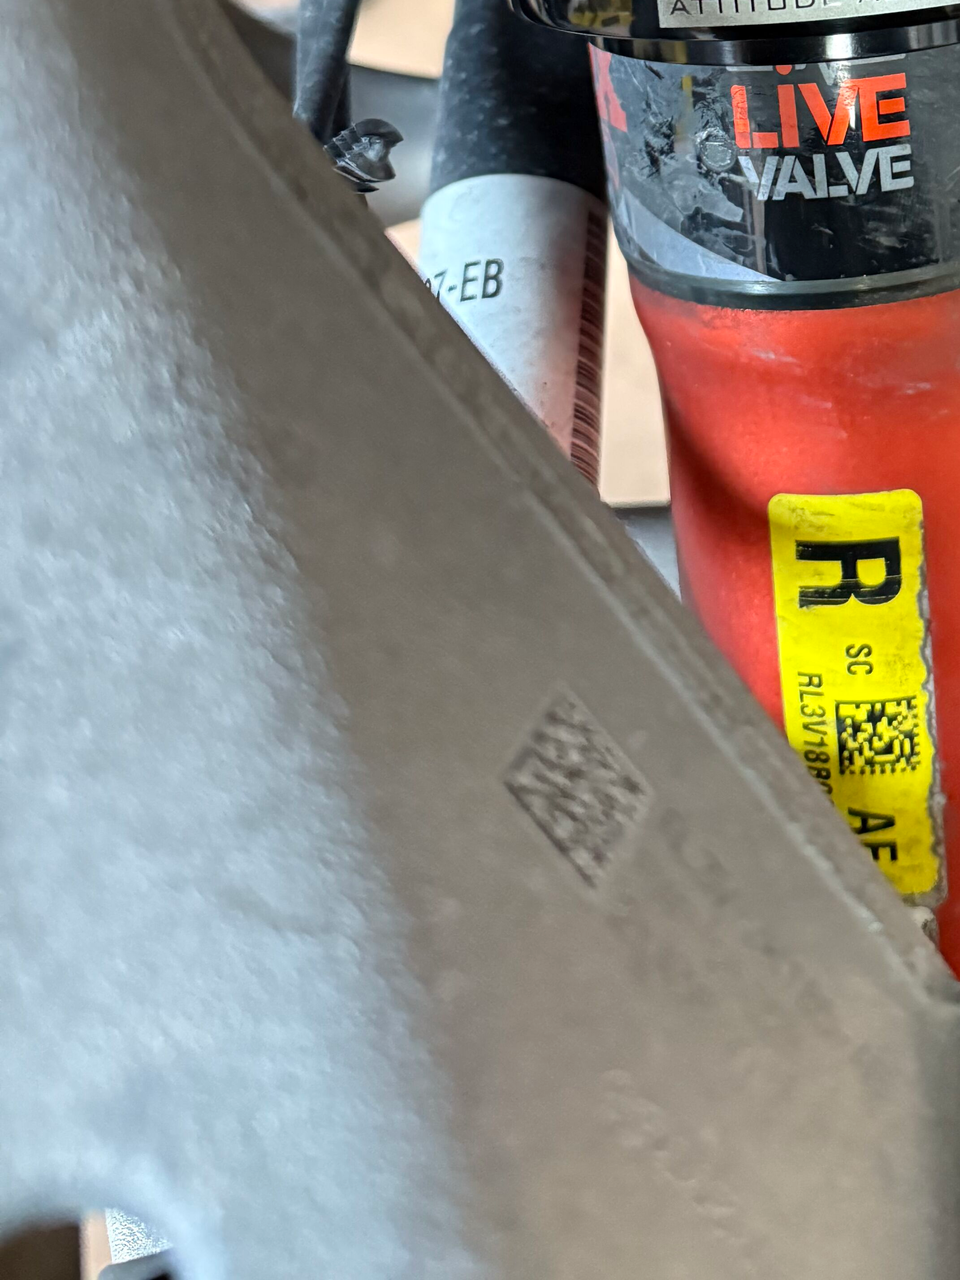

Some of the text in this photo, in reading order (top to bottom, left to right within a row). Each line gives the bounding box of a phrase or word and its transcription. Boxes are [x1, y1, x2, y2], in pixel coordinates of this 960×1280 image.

[737, 143, 915, 201] VALVE
[794, 536, 901, 609] R
[844, 642, 875, 677] SC
